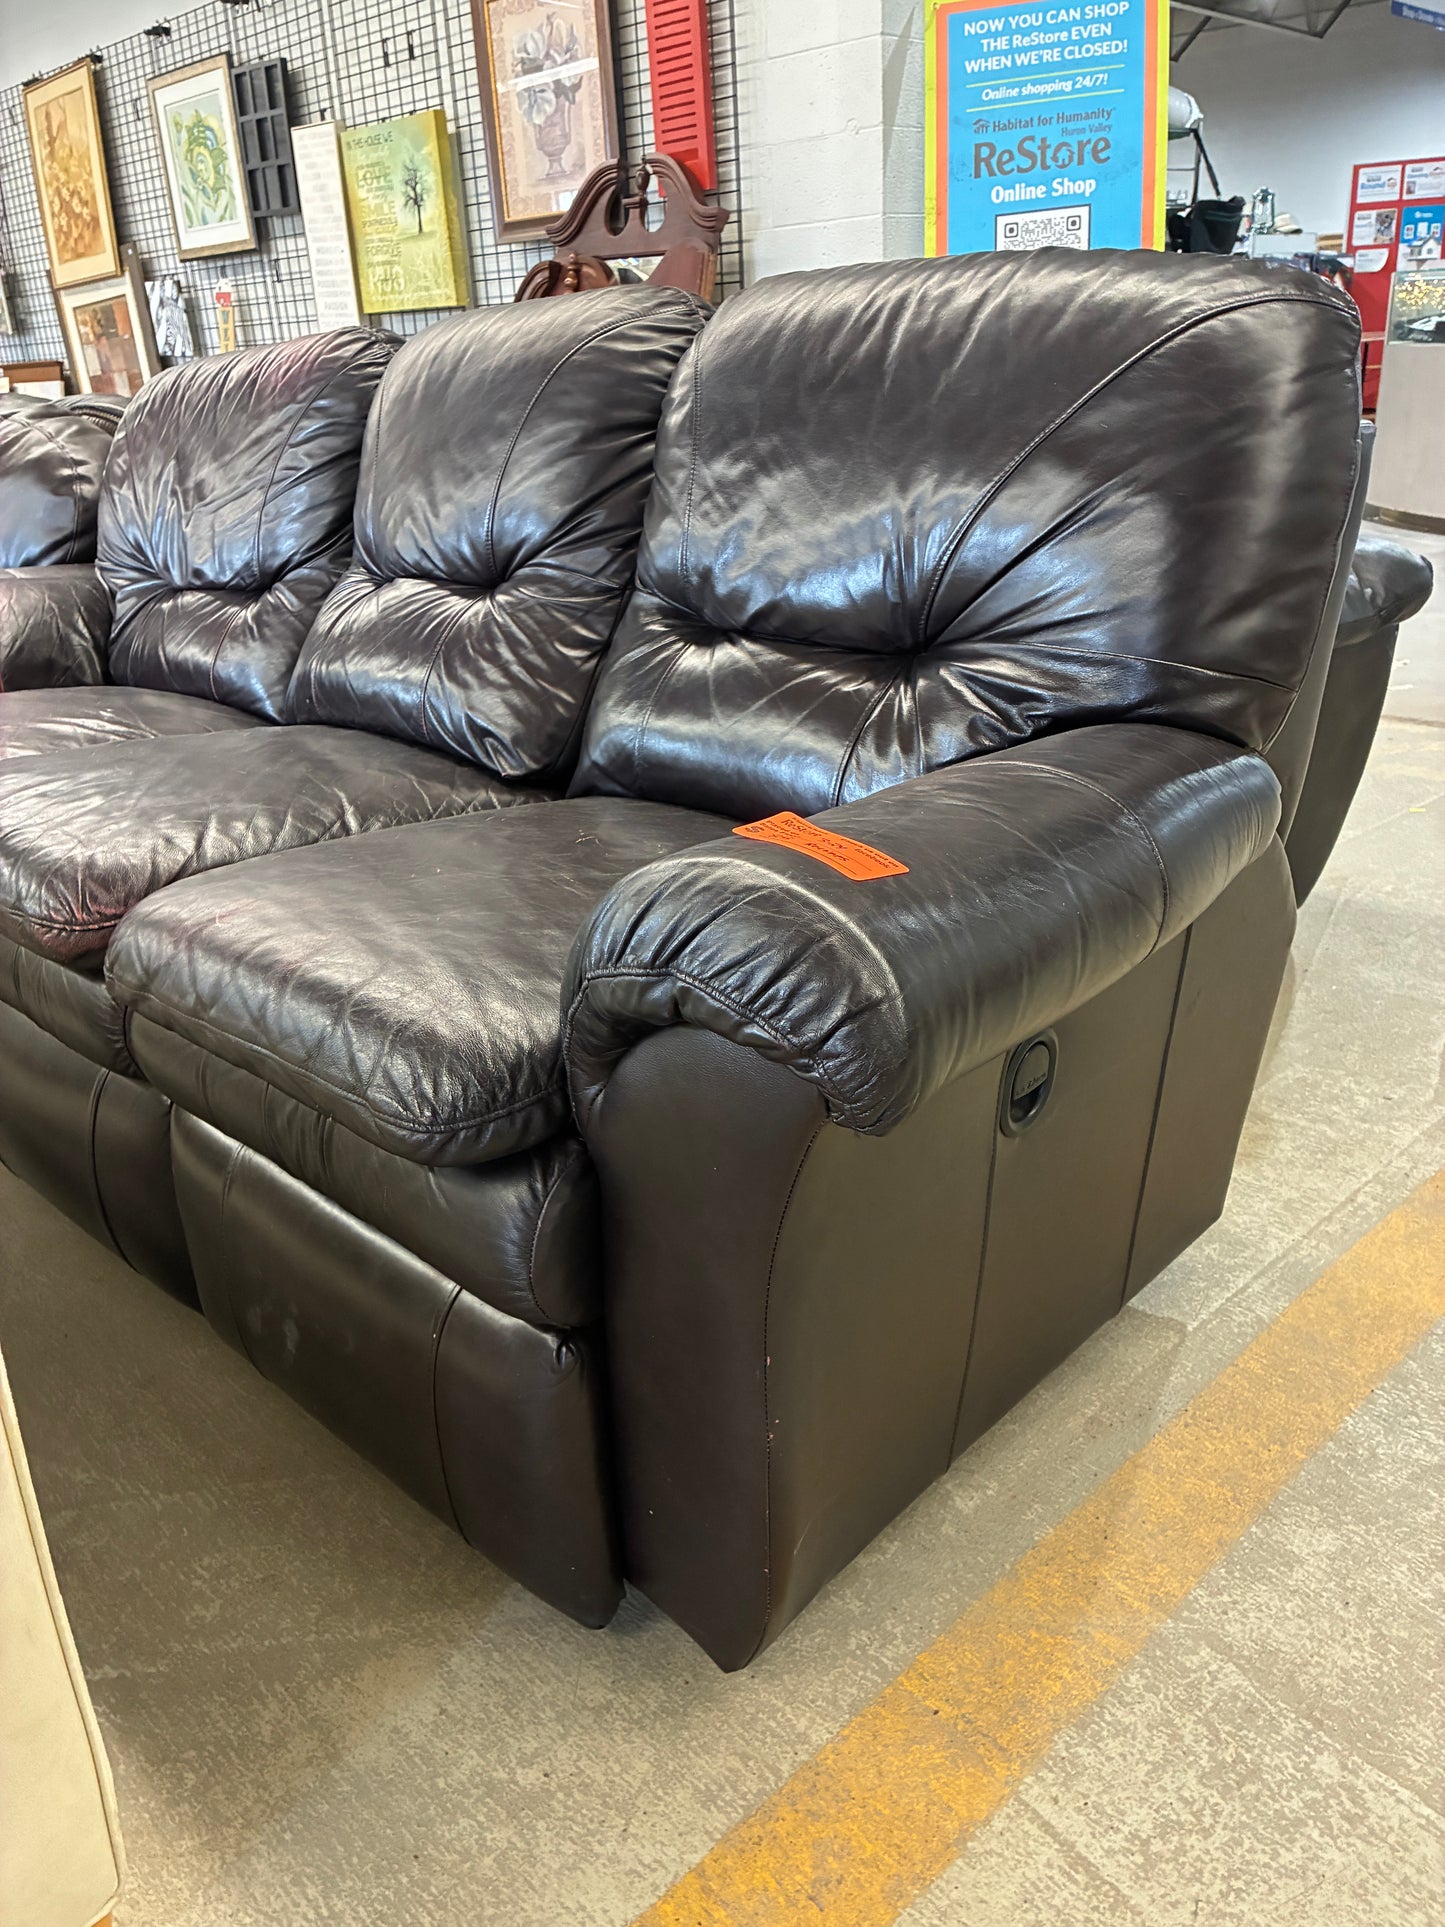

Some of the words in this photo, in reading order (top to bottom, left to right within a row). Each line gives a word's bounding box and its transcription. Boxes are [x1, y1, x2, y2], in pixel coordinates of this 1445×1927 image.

[963, 17, 1005, 37] NOW
[1008, 12, 1043, 30] YOU
[1046, 7, 1081, 24] CAN
[1084, 1, 1130, 19] SHOP
[980, 36, 1010, 53] THE
[1012, 31, 1069, 49] ReStore
[1071, 22, 1112, 41] EVEN
[964, 54, 1012, 74] WHEN
[1014, 46, 1062, 67] WE'RE
[1063, 39, 1128, 60] CLOSED!
[982, 84, 1020, 101] Online
[1021, 79, 1073, 96] shopping
[1074, 73, 1108, 90] 24/7!
[992, 117, 1034, 133] Habitat
[1037, 114, 1053, 127] for
[1056, 107, 1113, 125] Humanity
[1061, 126, 1087, 137] Huron
[1088, 122, 1112, 134] Valley
[973, 134, 1112, 180] ReStore
[356, 164, 393, 189] LOVE
[990, 182, 1047, 204] Online
[1051, 177, 1097, 198] Shop
